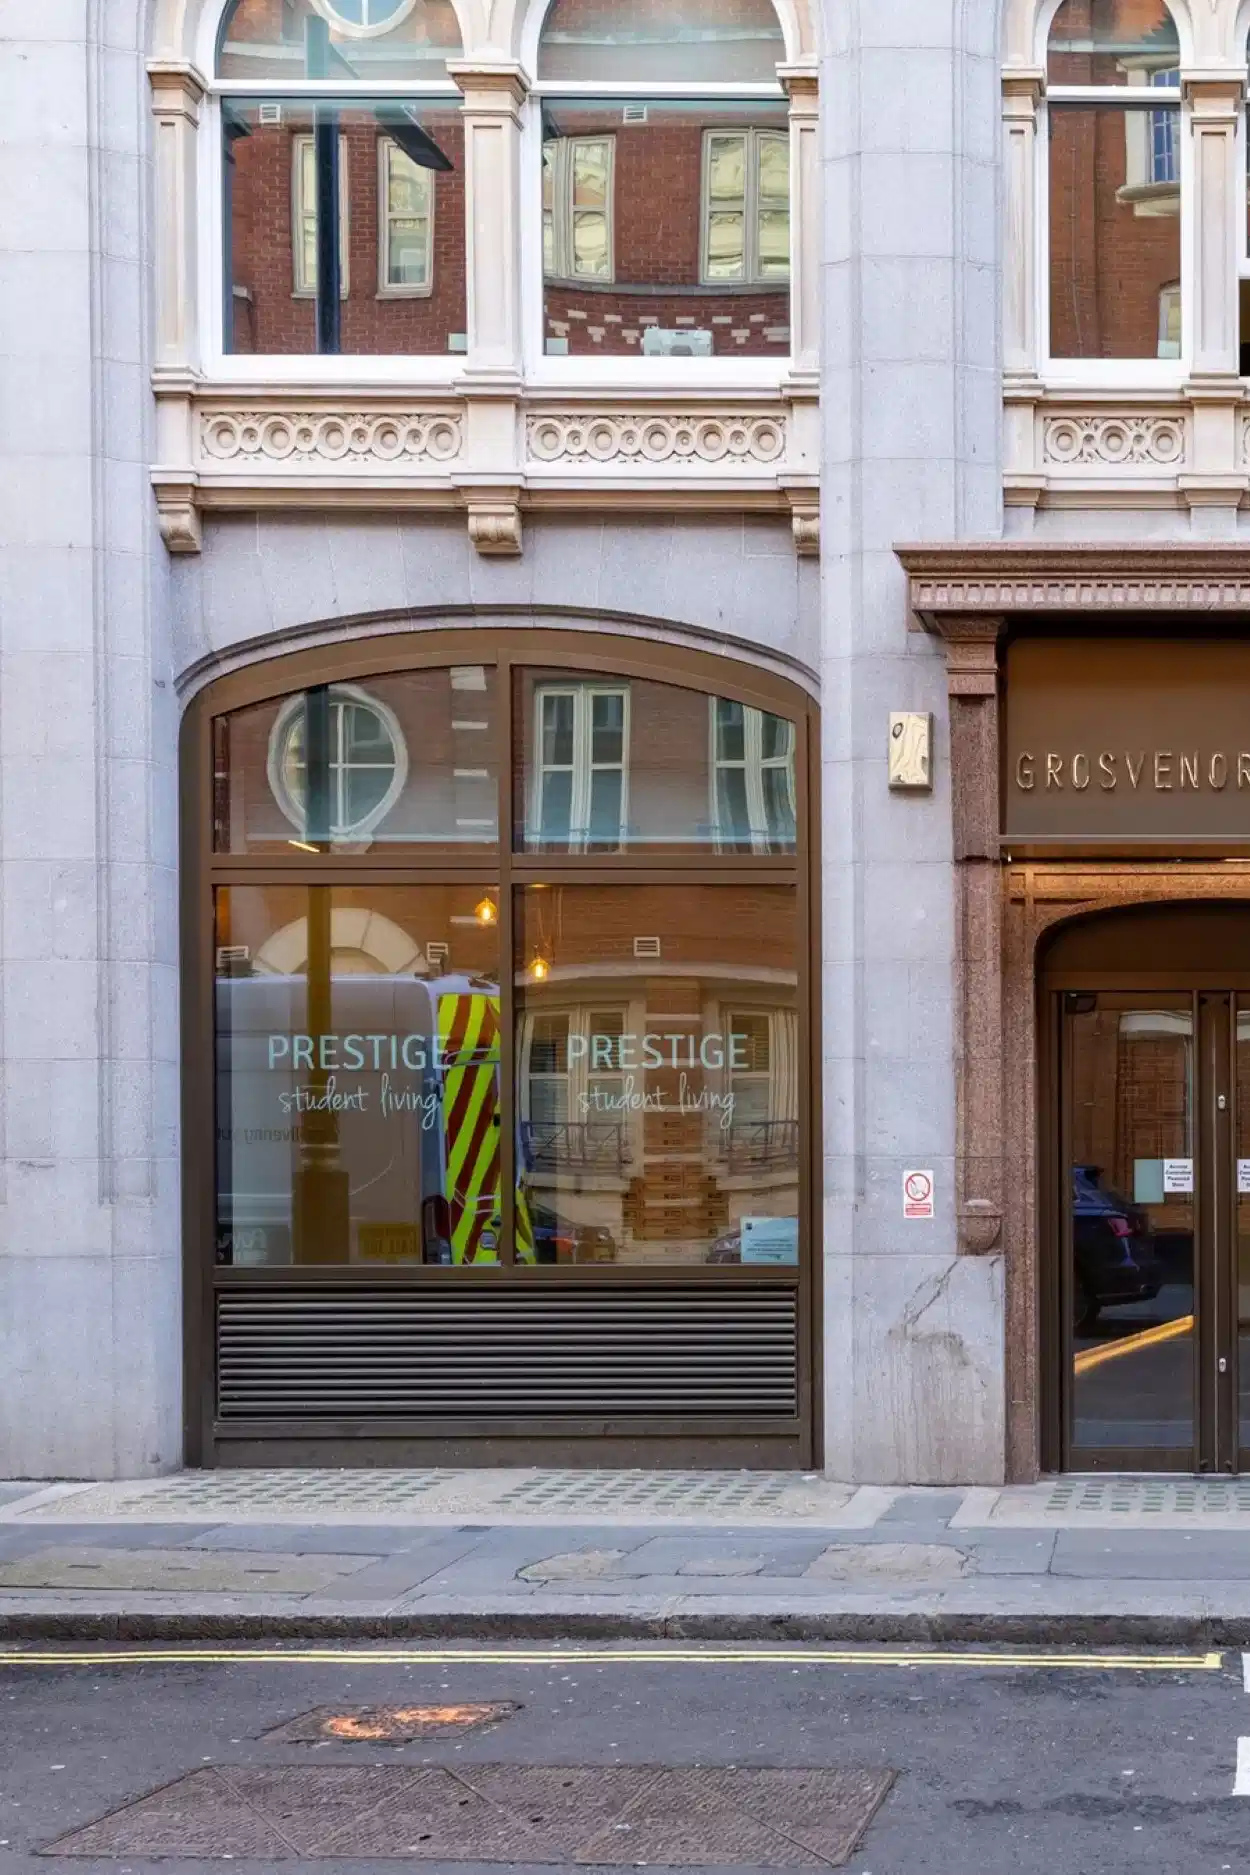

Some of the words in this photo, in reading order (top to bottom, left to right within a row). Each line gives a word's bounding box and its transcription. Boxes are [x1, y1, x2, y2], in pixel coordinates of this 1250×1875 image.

[267, 1034, 450, 1070] PRESTIGE
[567, 1033, 750, 1070] PRESTIGE
[277, 1075, 369, 1114] student
[379, 1072, 441, 1131] living
[576, 1074, 669, 1114] student
[678, 1071, 736, 1130] living
